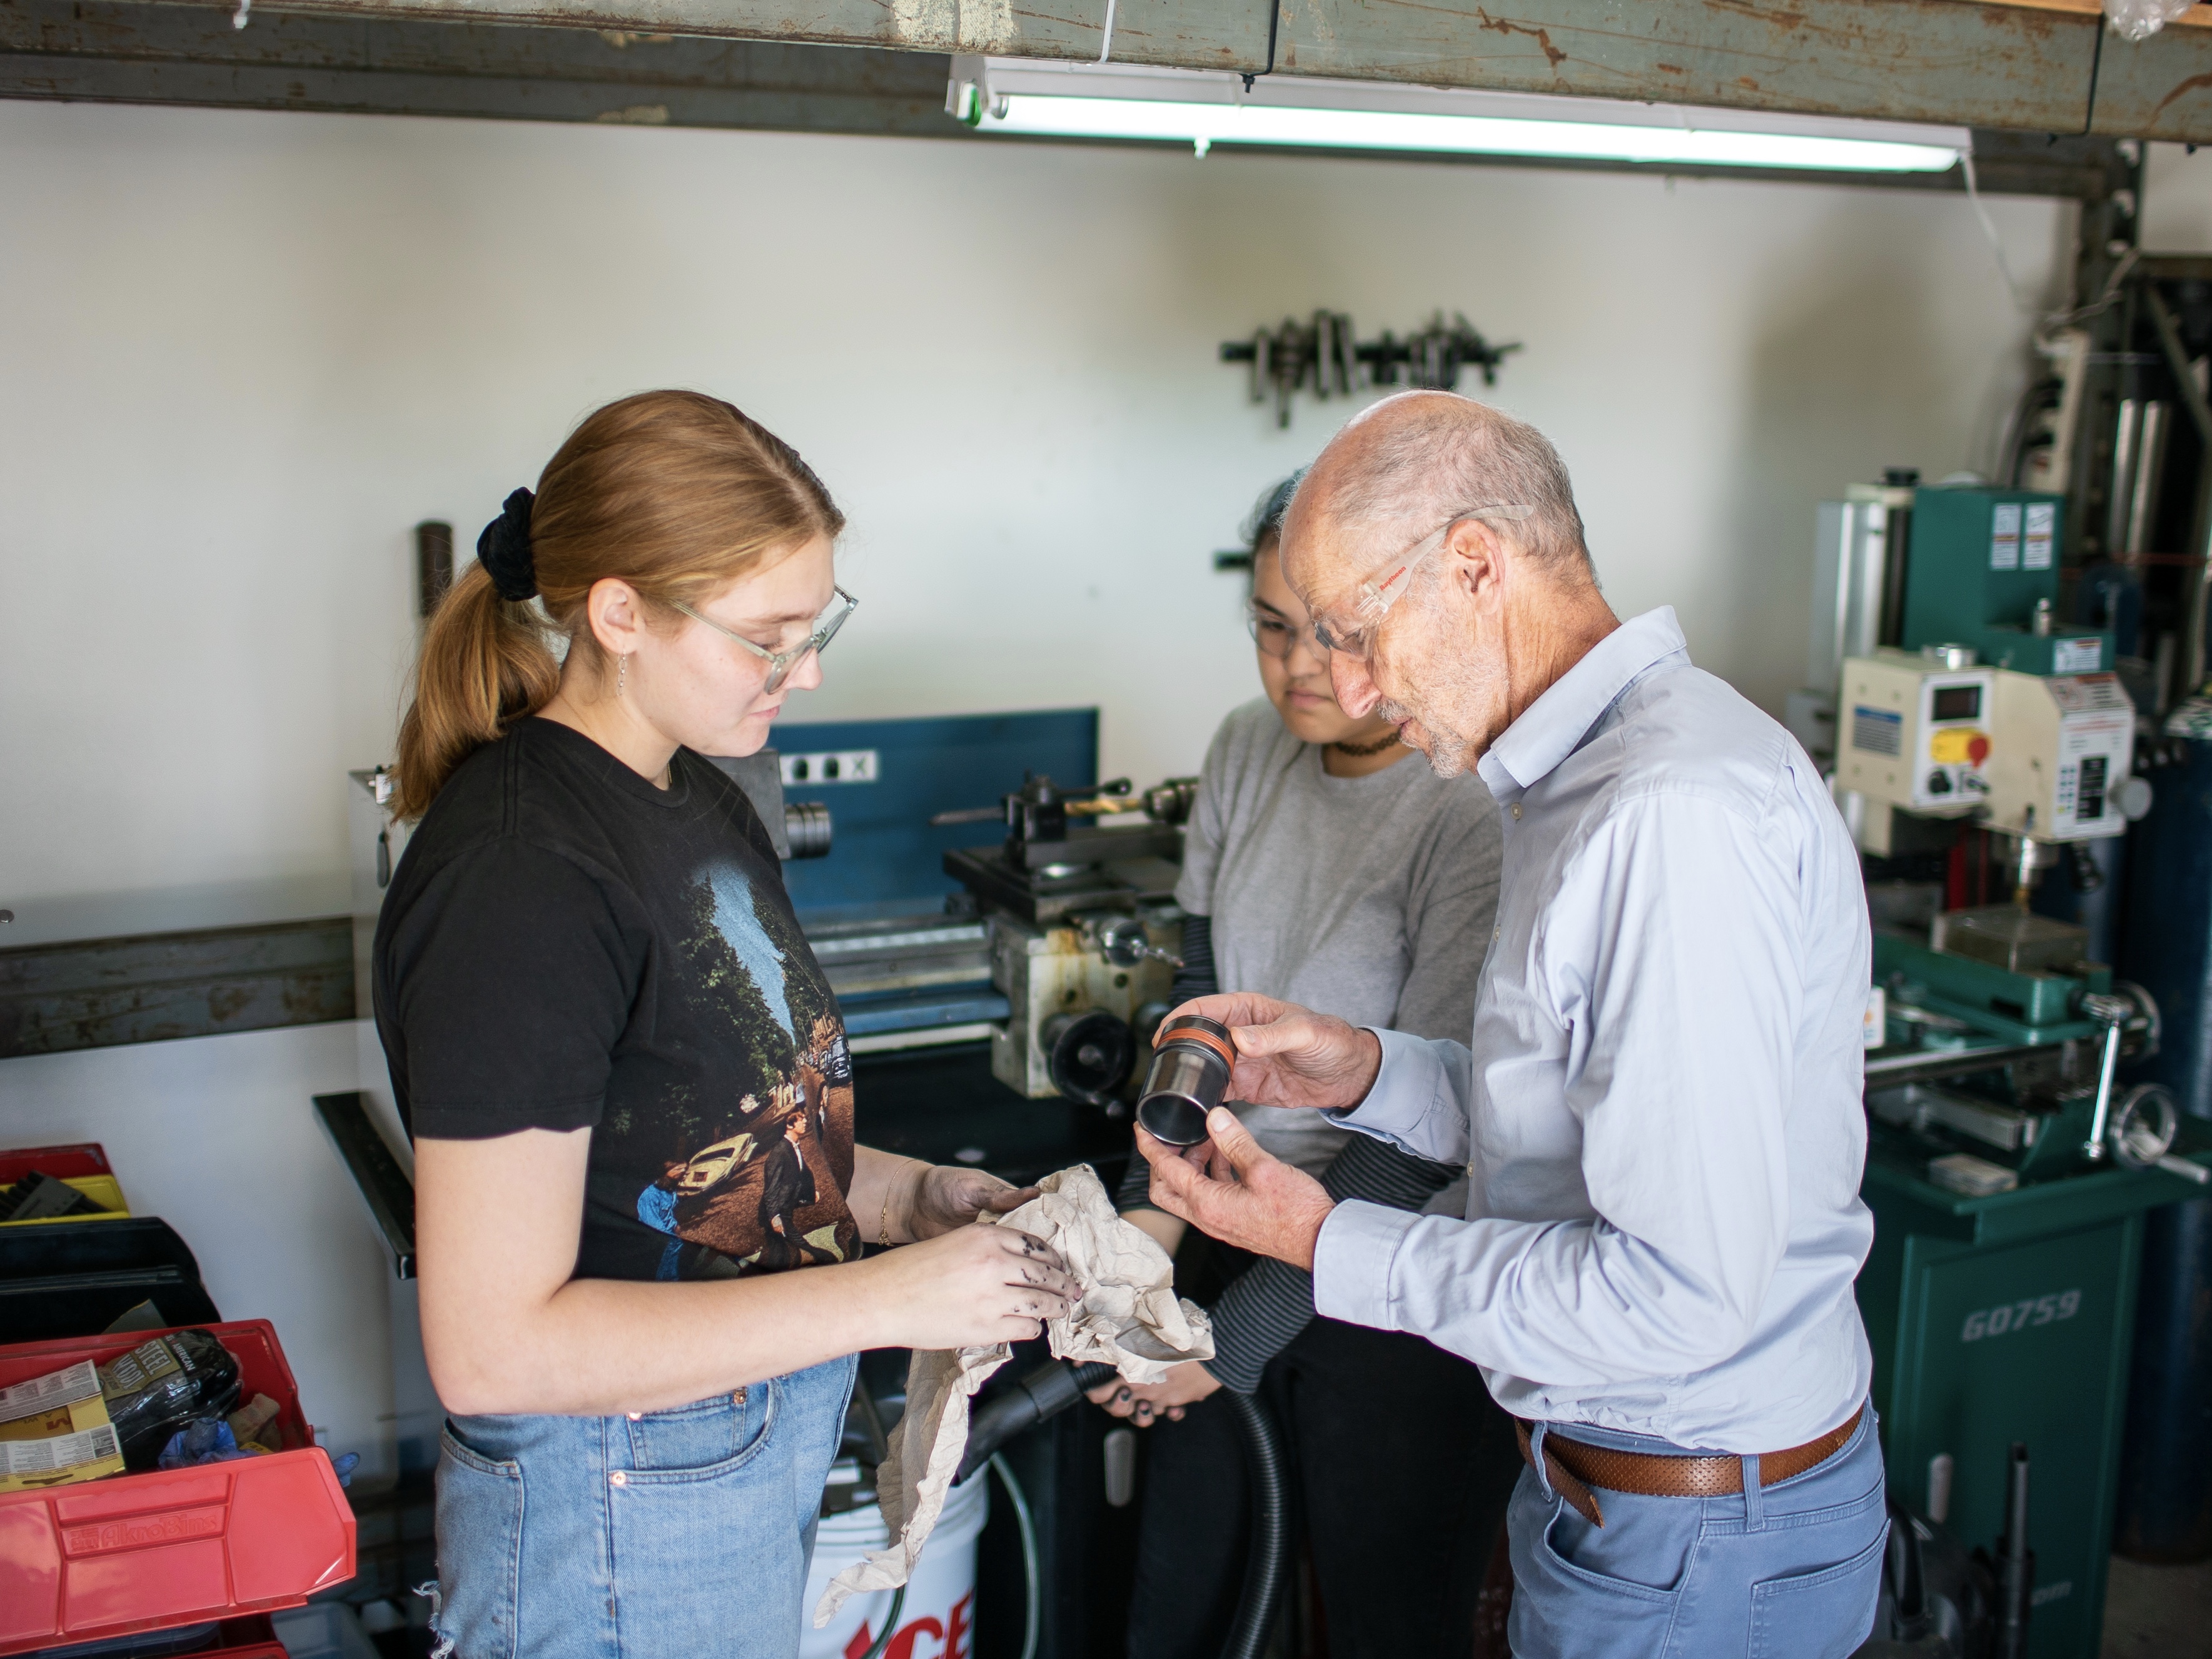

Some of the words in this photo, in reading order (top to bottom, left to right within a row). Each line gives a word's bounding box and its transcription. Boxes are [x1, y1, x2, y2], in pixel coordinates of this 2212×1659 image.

[1379, 566, 1406, 591] Raytheon
[111, 1353, 145, 1389] WOOL
[134, 1339, 171, 1376] STEEL
[172, 1343, 196, 1371] AMERICAN
